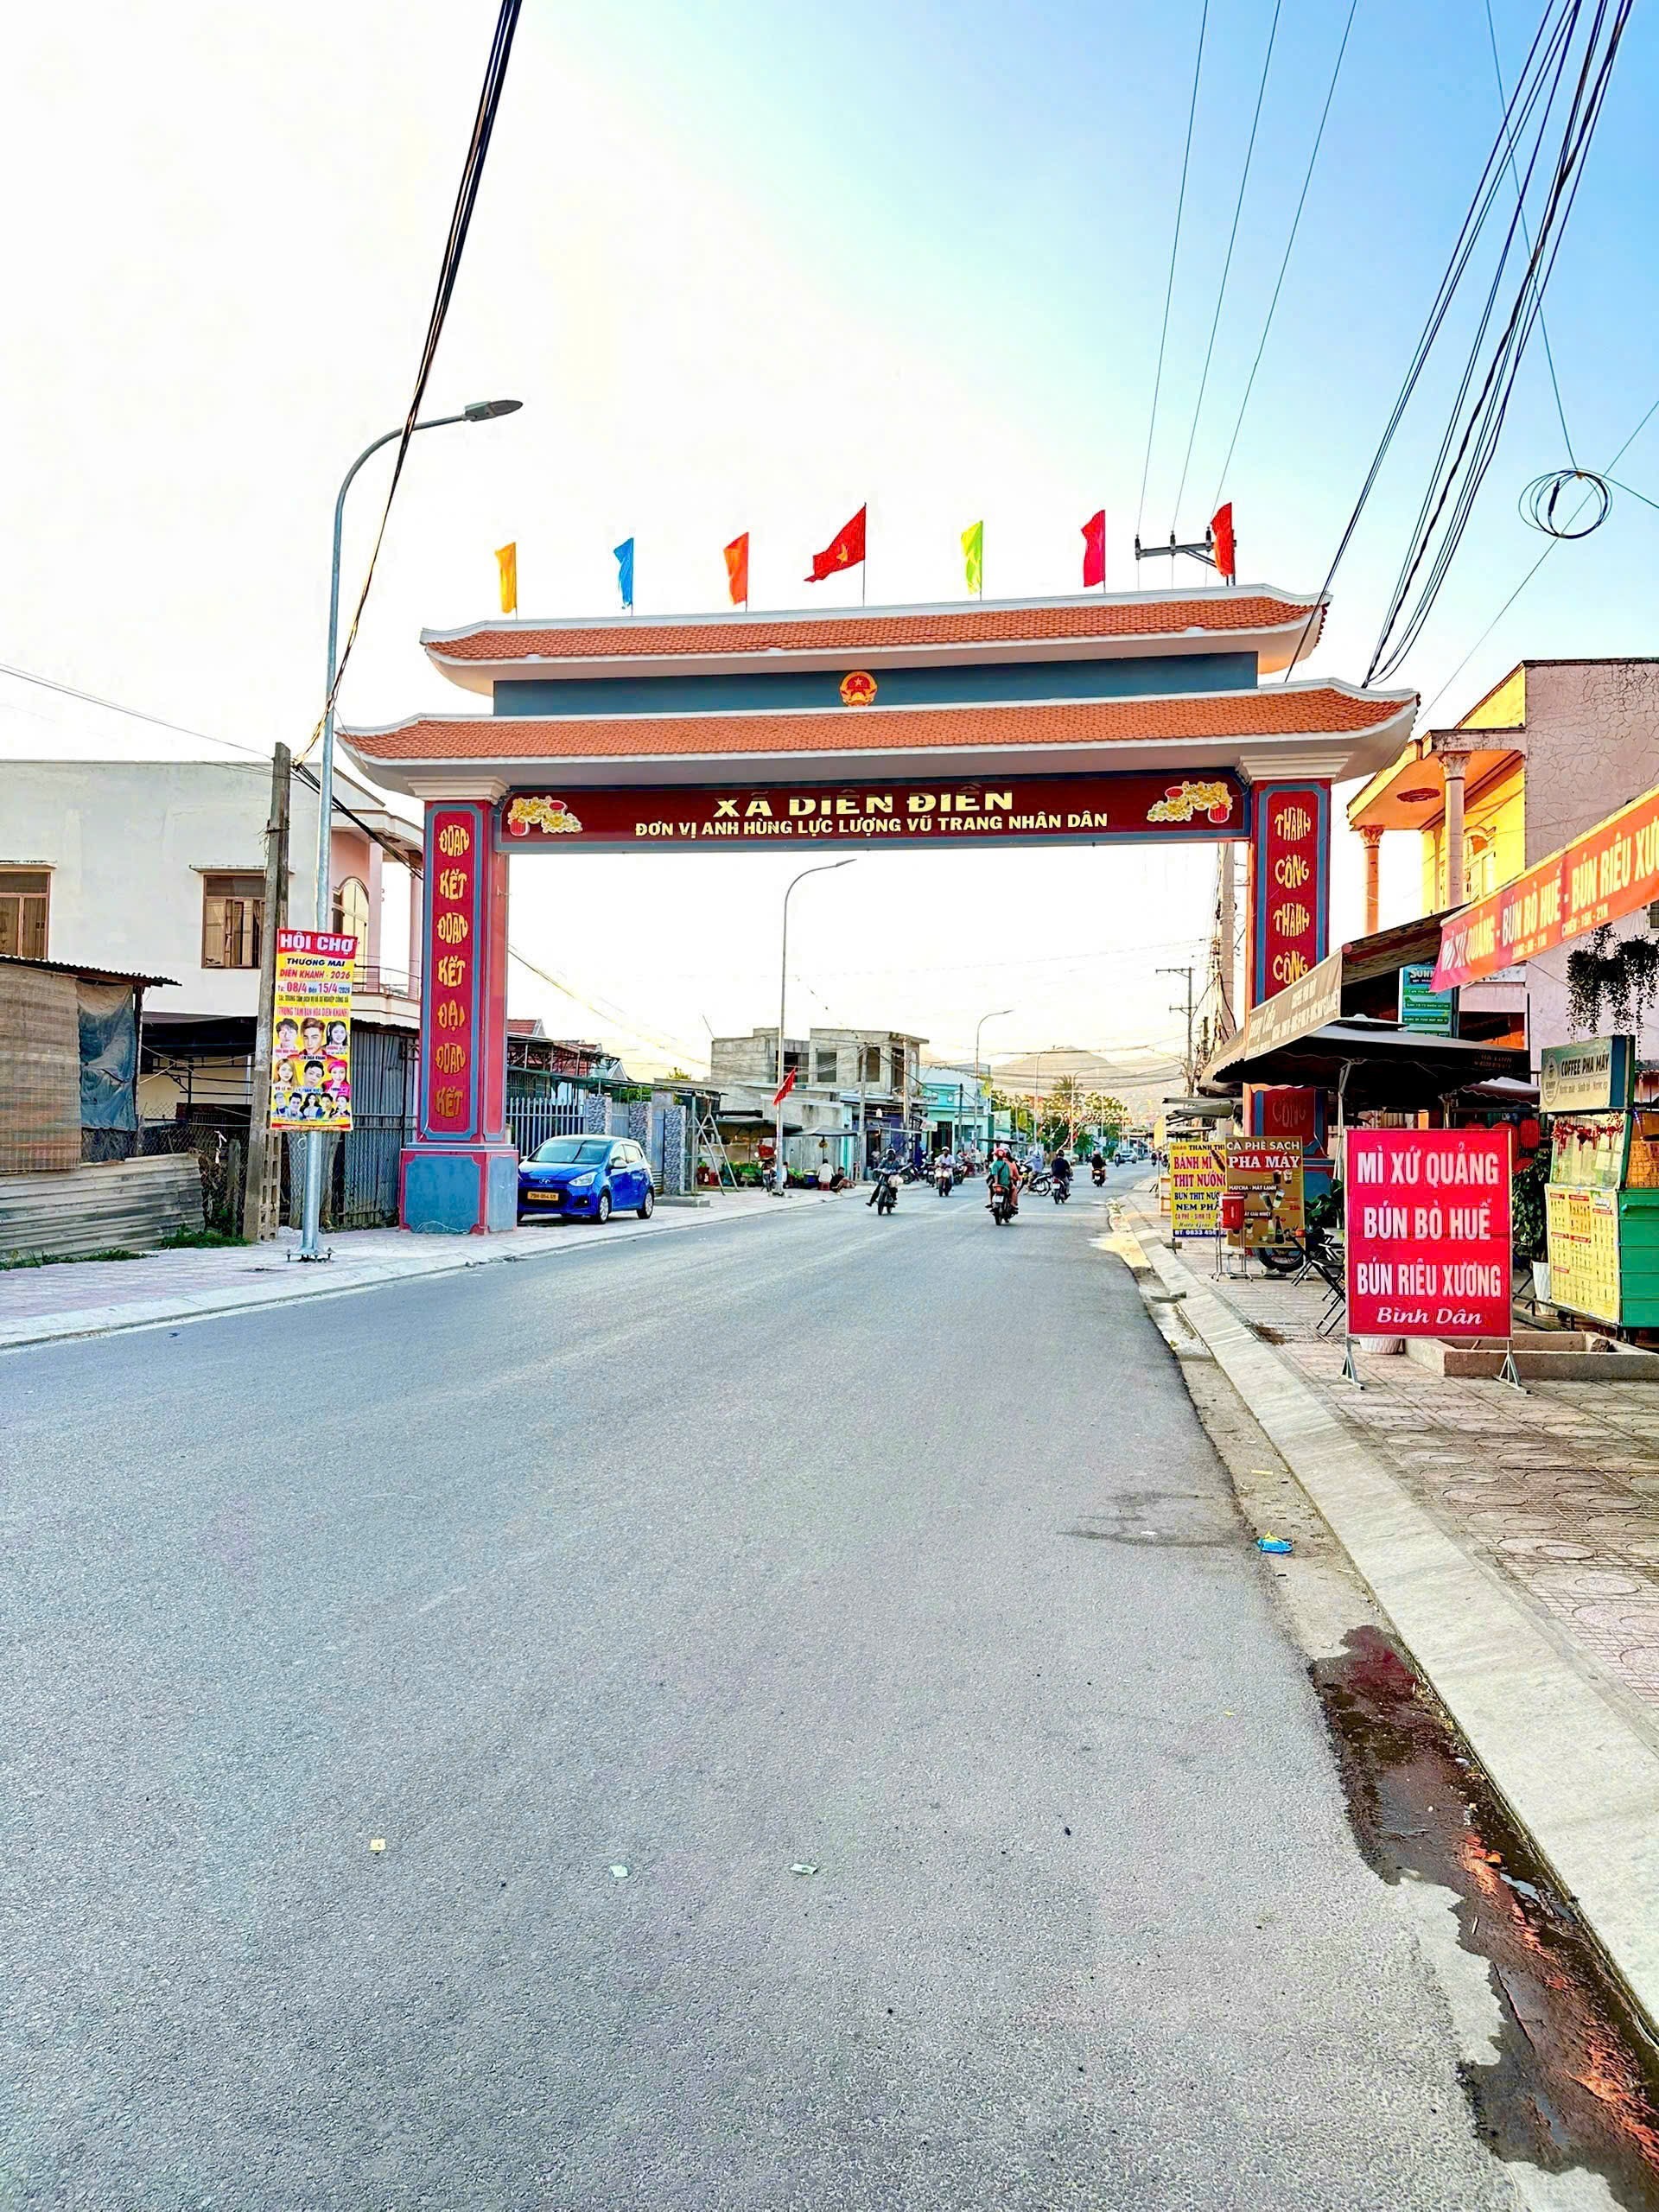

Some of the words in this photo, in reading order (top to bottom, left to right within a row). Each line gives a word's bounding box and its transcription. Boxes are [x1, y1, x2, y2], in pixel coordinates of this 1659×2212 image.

[713, 791, 772, 817] XÃ
[789, 788, 893, 817] DIÊN
[635, 820, 673, 836] ĐƠN
[678, 822, 696, 839] VỊ
[702, 821, 739, 836] ANH
[744, 817, 792, 835] HÙNG
[798, 817, 833, 837] LỰC
[839, 816, 901, 837] LƯỢNG
[907, 815, 932, 832] VŨ
[938, 816, 1002, 831] TRANG
[1009, 810, 1061, 830] NHÂN
[1068, 810, 1107, 828] DÂN
[1274, 806, 1312, 842] THÀNH
[439, 868, 467, 900] KẾT
[1274, 854, 1310, 889] CÔNG
[1502, 895, 1522, 948] BÚN
[1523, 881, 1538, 938] BÒ
[1540, 862, 1562, 930] HUẾ
[1572, 852, 1598, 914] BÚN
[1600, 831, 1632, 899] RIÊU
[1273, 902, 1310, 938] THÀNH
[280, 931, 312, 952] HỘI
[317, 937, 355, 956] CHỢ
[287, 957, 325, 966] THƯƠNG
[330, 970, 351, 980] 2026
[437, 956, 466, 988] KẾT
[1272, 950, 1308, 985] CÔNG
[286, 982, 307, 993] 08/4
[319, 982, 338, 994] 15/4
[437, 1000, 466, 1032] ĐẠI
[1560, 1058, 1581, 1077] COFFEE
[1581, 1056, 1594, 1075] PHA
[1596, 1049, 1610, 1072] MÁY
[1226, 1139, 1242, 1151] CÀ
[1245, 1139, 1266, 1150] PHÊ
[1269, 1141, 1300, 1152] SẠCH
[1227, 1155, 1262, 1168] PHA
[1265, 1151, 1300, 1168] MÁY
[1174, 1153, 1198, 1170] BÁNH
[1357, 1146, 1383, 1185] MÌ
[1390, 1146, 1421, 1185] XỨ
[1426, 1141, 1499, 1188] QUẢNG
[1363, 1200, 1408, 1239] BÚN
[1414, 1199, 1442, 1240] BÒ
[1449, 1198, 1492, 1241] HUẾ
[1357, 1256, 1392, 1296] BÚN
[1398, 1258, 1437, 1297] RIÊU
[1441, 1261, 1501, 1298] XƯƠNG
[1376, 1306, 1429, 1324] Bình
[1435, 1307, 1483, 1325] Dân
